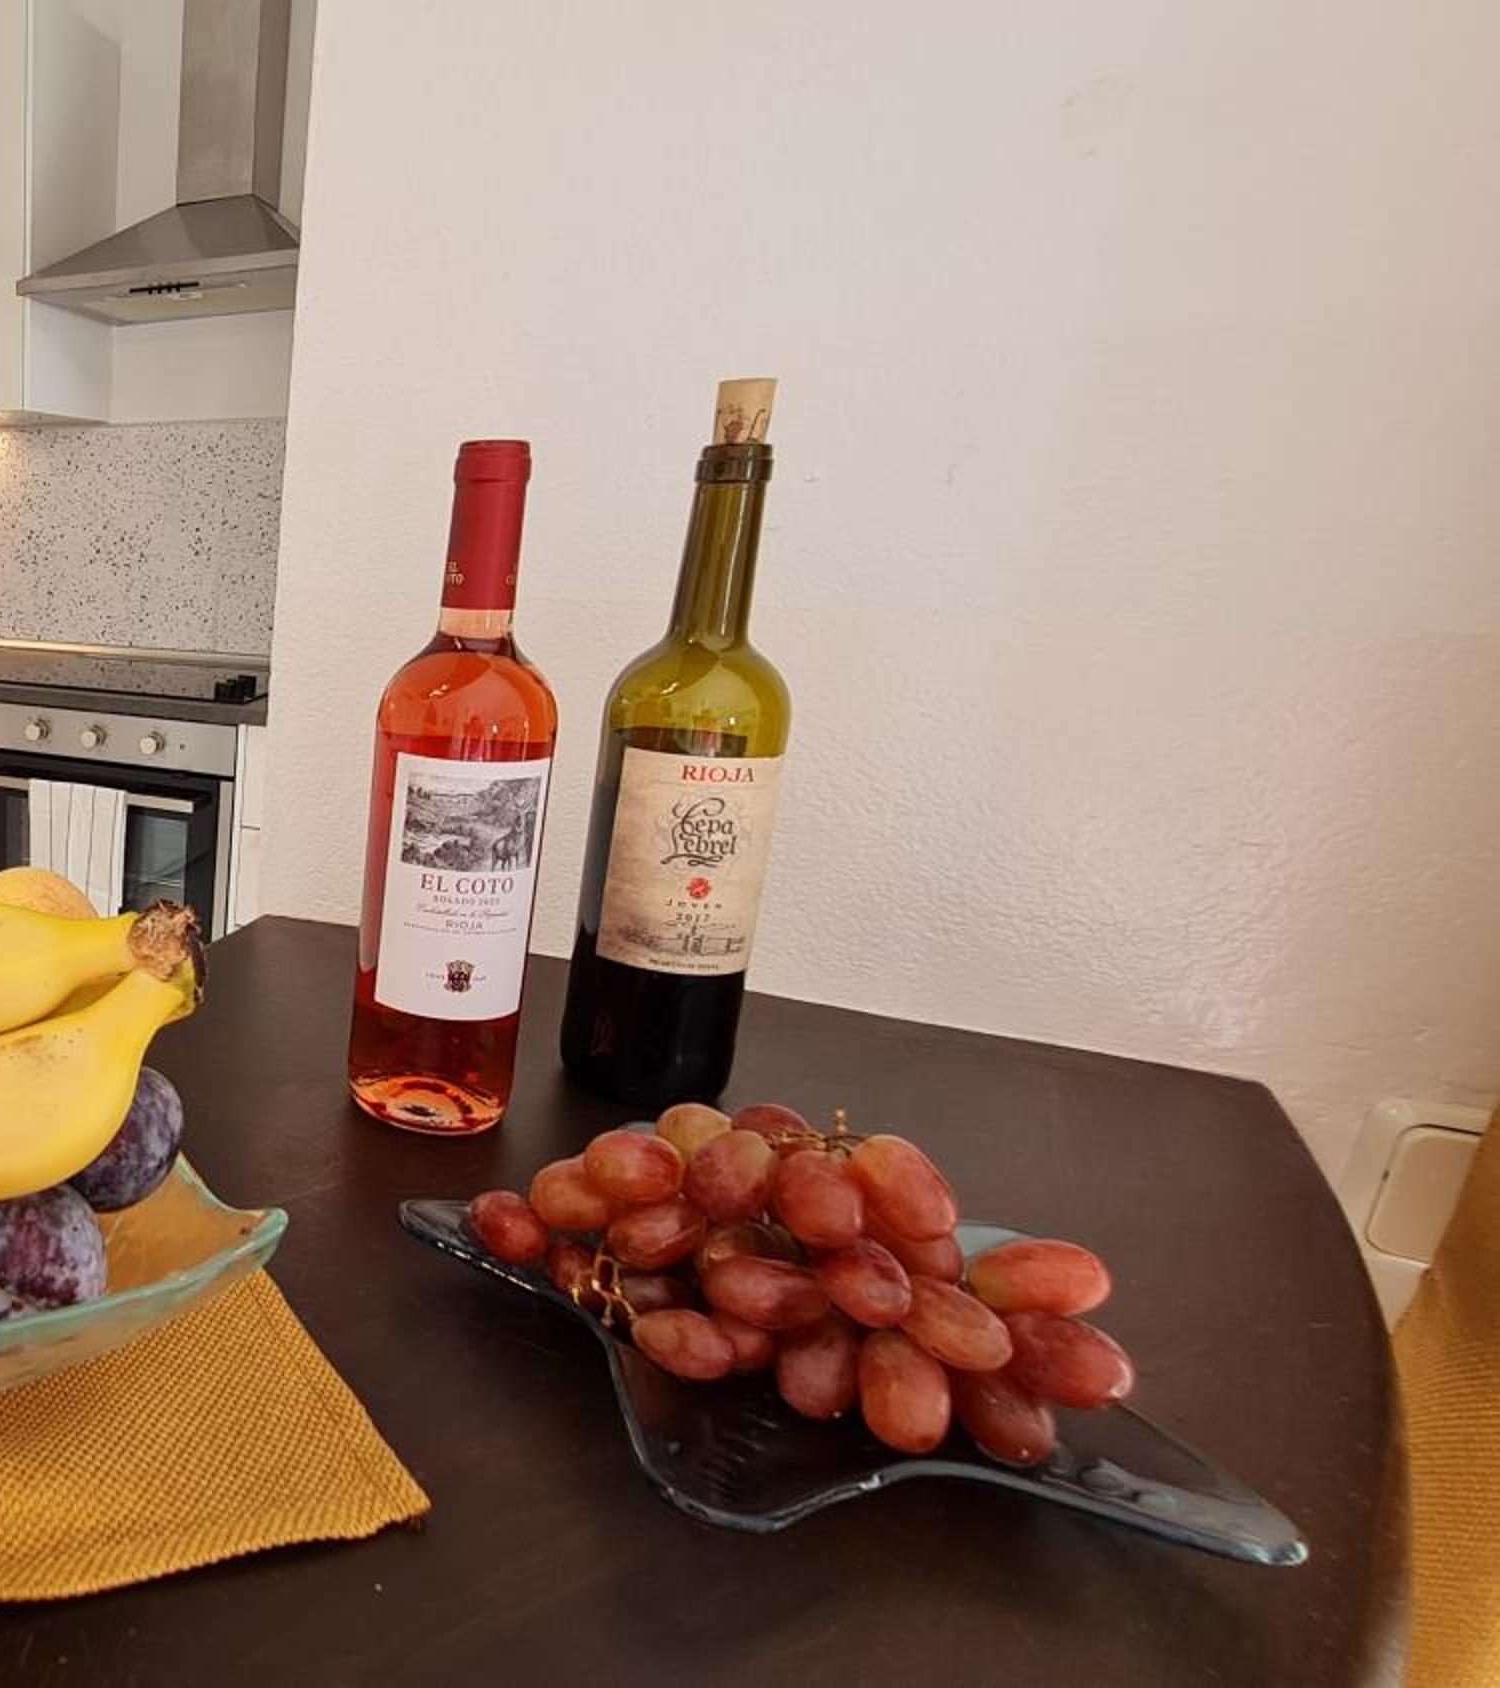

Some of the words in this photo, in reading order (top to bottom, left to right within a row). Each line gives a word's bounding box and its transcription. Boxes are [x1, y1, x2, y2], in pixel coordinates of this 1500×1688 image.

[682, 765, 754, 783] RIOJA
[672, 797, 734, 840] Cepa
[421, 874, 449, 893] EL
[455, 877, 514, 895] COTO
[445, 920, 483, 930] RIOJA
[676, 912, 711, 923] 2017
